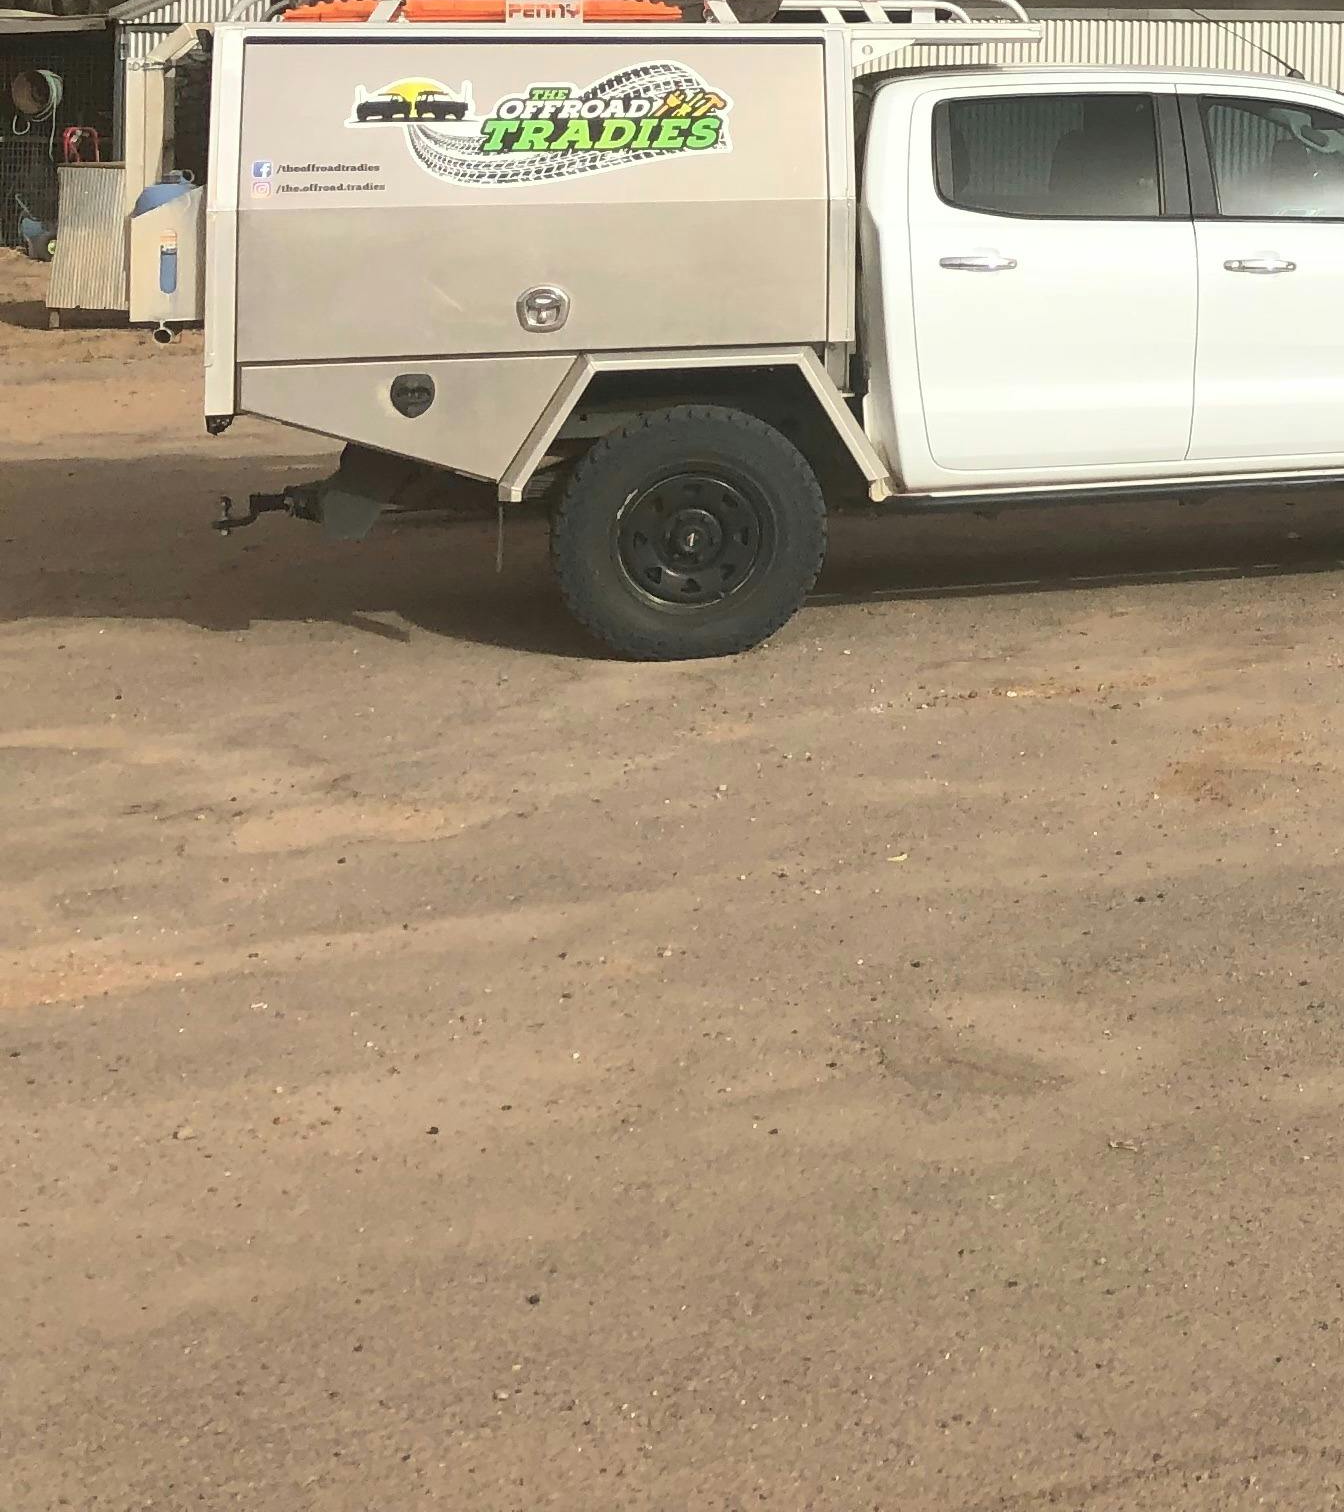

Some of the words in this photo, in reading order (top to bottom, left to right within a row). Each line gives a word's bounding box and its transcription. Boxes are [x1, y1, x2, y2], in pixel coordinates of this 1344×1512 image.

[531, 89, 569, 100] THE
[500, 99, 650, 119] OFFROAD
[483, 117, 722, 150] TRADIES
[276, 163, 380, 174] /theoffroadtradies
[276, 183, 386, 194] /the.offroad.tradies
